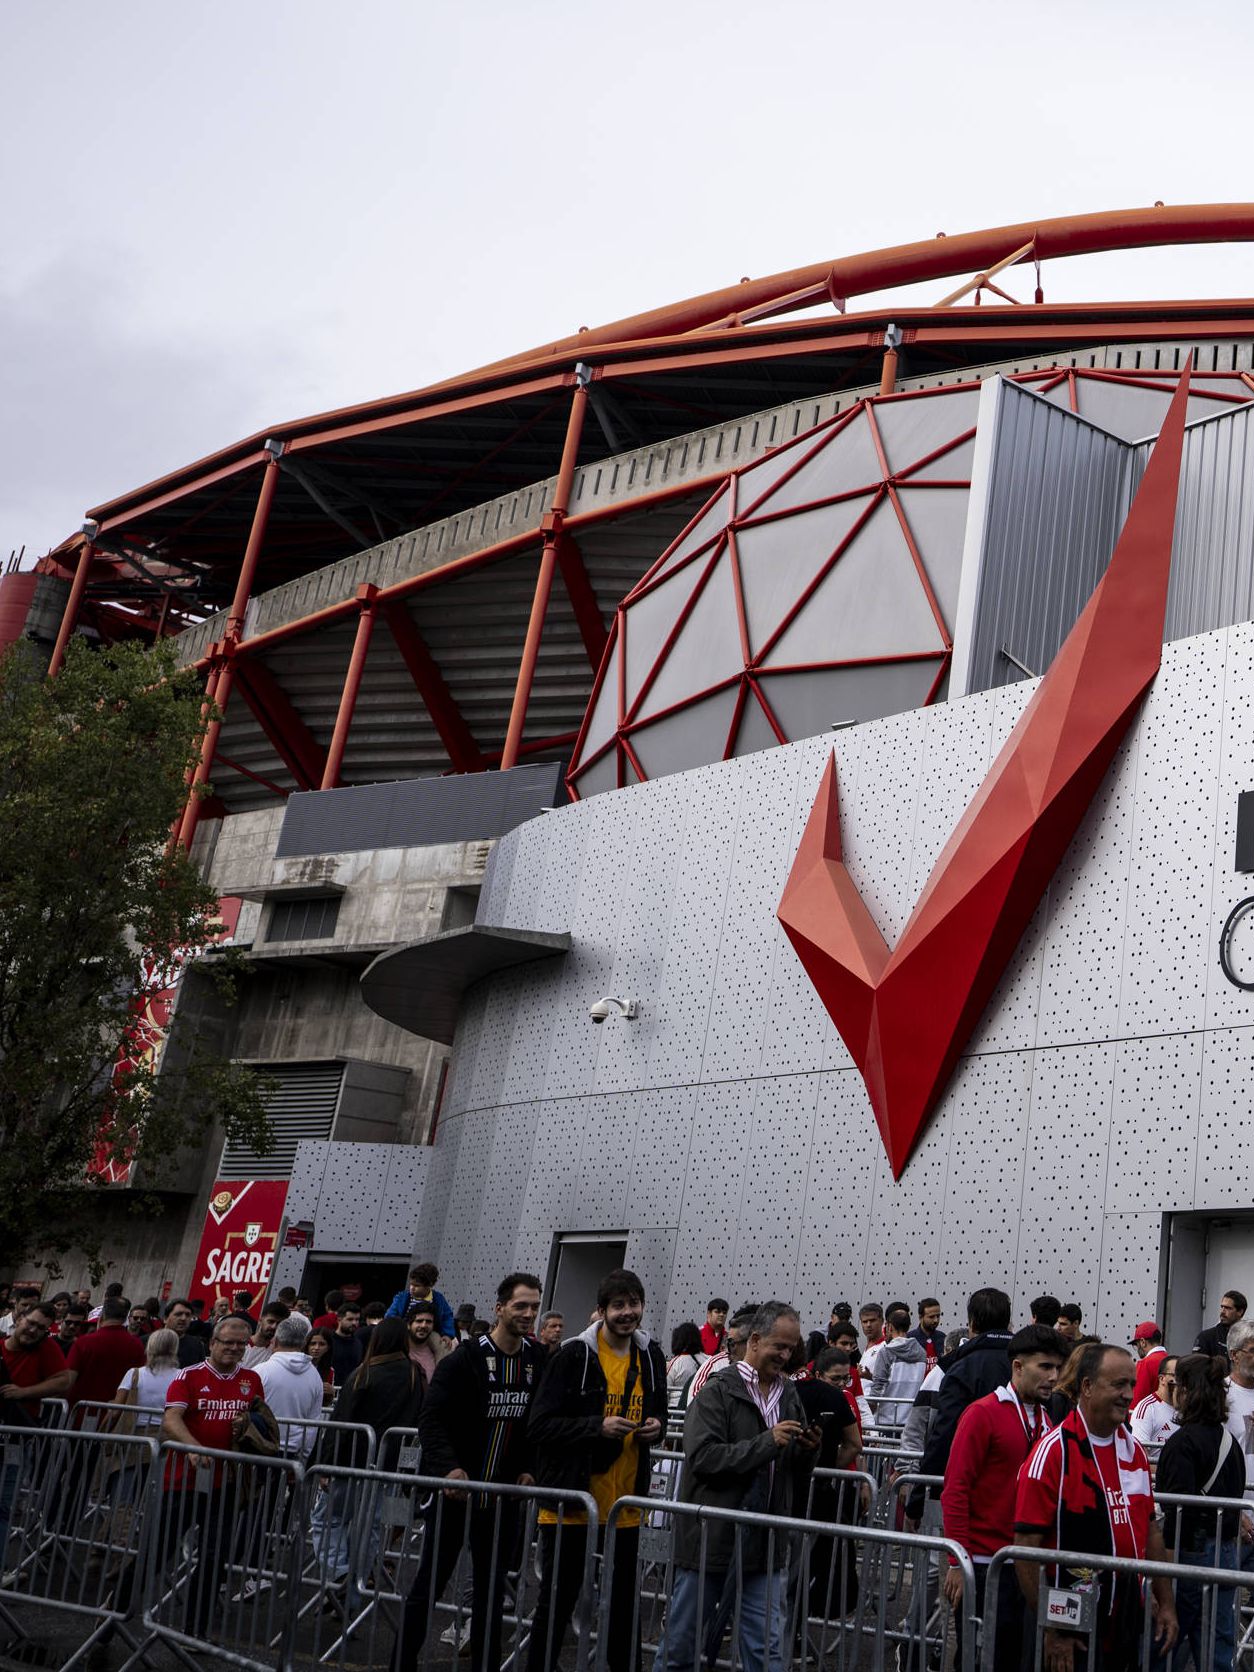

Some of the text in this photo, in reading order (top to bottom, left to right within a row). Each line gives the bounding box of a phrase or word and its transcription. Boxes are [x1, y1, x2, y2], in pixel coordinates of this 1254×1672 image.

[201, 1248, 275, 1286] SAGRE
[488, 1388, 531, 1405] mirate
[1049, 1603, 1078, 1617] SETUP
